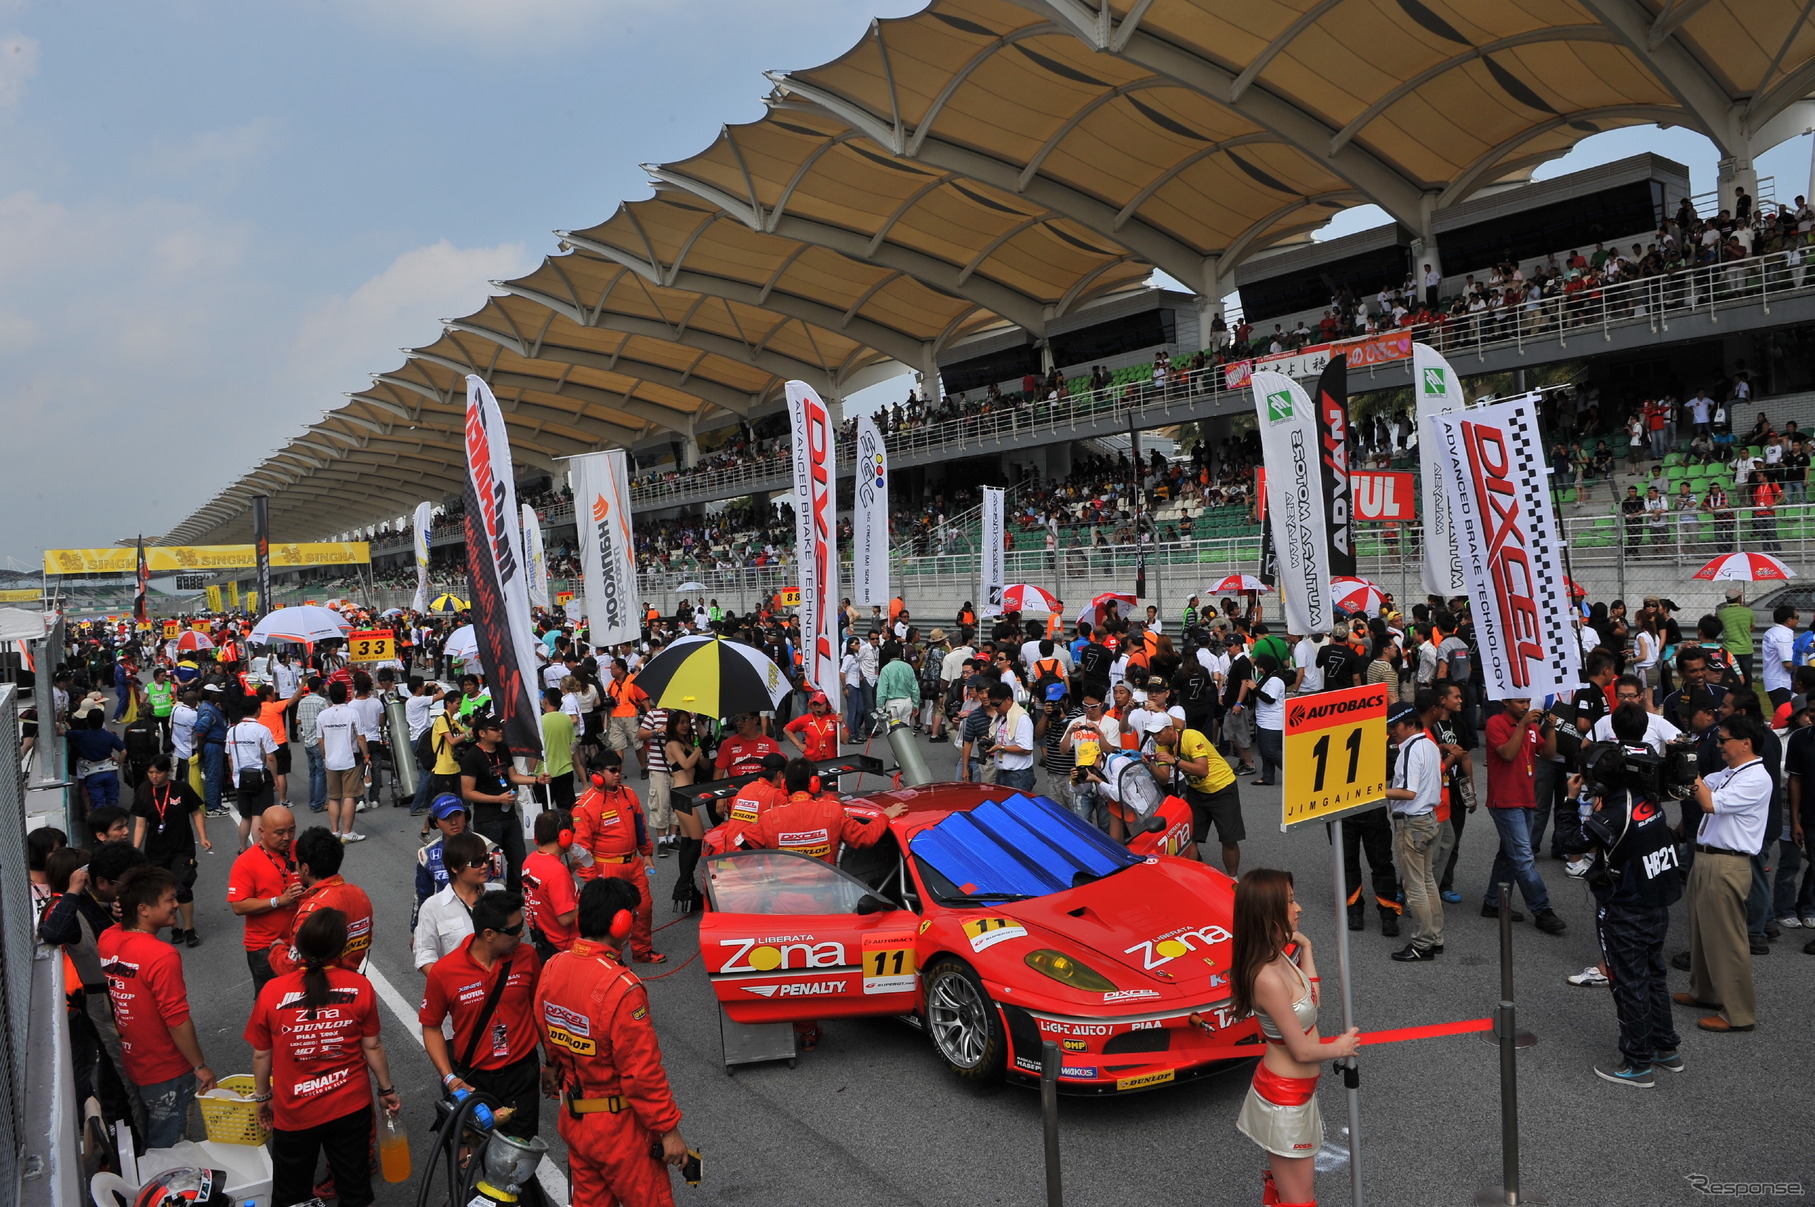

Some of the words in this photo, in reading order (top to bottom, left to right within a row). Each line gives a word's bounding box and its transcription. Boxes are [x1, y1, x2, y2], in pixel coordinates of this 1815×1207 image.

[795, 400, 807, 497] ADVANCED
[801, 501, 812, 560] BRAKE
[1330, 409, 1348, 557] ADVAN
[201, 556, 257, 566] SINGHA
[305, 552, 356, 562] SINGHA
[1444, 423, 1470, 514] ADVANCED
[1465, 520, 1482, 575] BRAKE
[1476, 579, 1506, 691] TECHNOLOGY
[1474, 422, 1545, 688] DIXCEL
[88, 560, 136, 570] SINGH
[166, 626, 175, 635] 43
[358, 640, 385, 656] 33
[1085, 652, 1099, 672] 7
[1328, 656, 1346, 678] 7
[1189, 679, 1204, 700] 7
[1306, 694, 1384, 720] AUTOBACS
[1312, 728, 1362, 792] 11
[1288, 783, 1383, 817] JIMGAINER
[1638, 816, 1656, 828] SUPER
[1656, 811, 1663, 819] GT
[780, 830, 827, 841] DIXCEL
[1642, 844, 1678, 880] HB21
[975, 918, 1007, 934] 11
[1151, 925, 1194, 943] LIBERATA
[758, 934, 815, 944] LIBERATA
[872, 937, 913, 945] AUTOBACS
[720, 938, 847, 974] Zona
[1124, 925, 1233, 971] Zona
[874, 951, 904, 975] 11
[460, 989, 484, 1001] MOTUL
[779, 980, 847, 997] PENALTY
[1104, 989, 1159, 1001] DIXCEL
[546, 1004, 587, 1027] DIXCEL
[293, 1019, 353, 1033] DUNLOP
[1072, 1025, 1107, 1036] AUTO
[1131, 1020, 1162, 1031] PIAA
[549, 1030, 591, 1050] DUNLOP
[1064, 1040, 1086, 1050] OMP
[294, 1068, 349, 1095] PENALTY
[1129, 1072, 1171, 1087] DUNLOP
